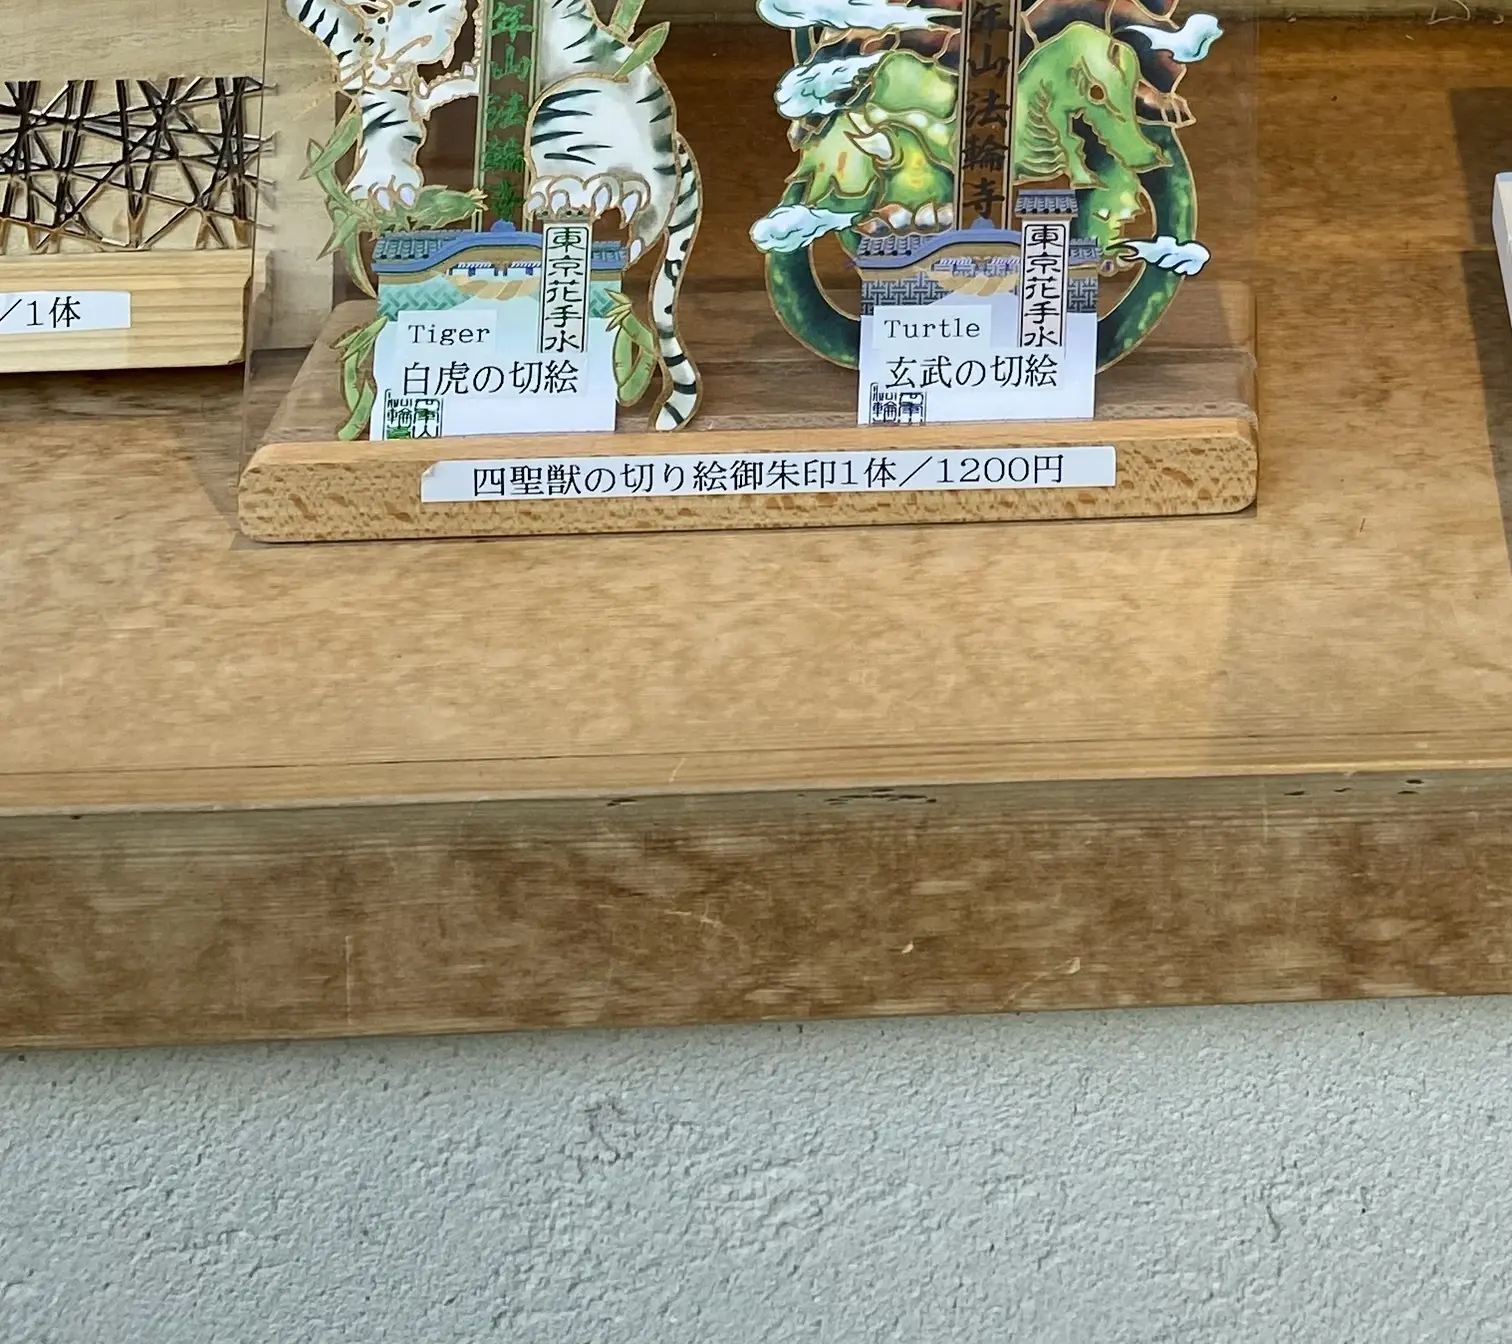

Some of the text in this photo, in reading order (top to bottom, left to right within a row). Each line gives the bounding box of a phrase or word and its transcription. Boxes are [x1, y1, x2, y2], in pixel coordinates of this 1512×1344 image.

[543, 227, 589, 353] 東京花手水
[1022, 224, 1065, 347] 東京花手水
[408, 324, 491, 346] Tiger
[884, 318, 981, 339] Turtle
[403, 359, 579, 397] 白虎の切絵
[885, 353, 1058, 389] 玄武の切絵
